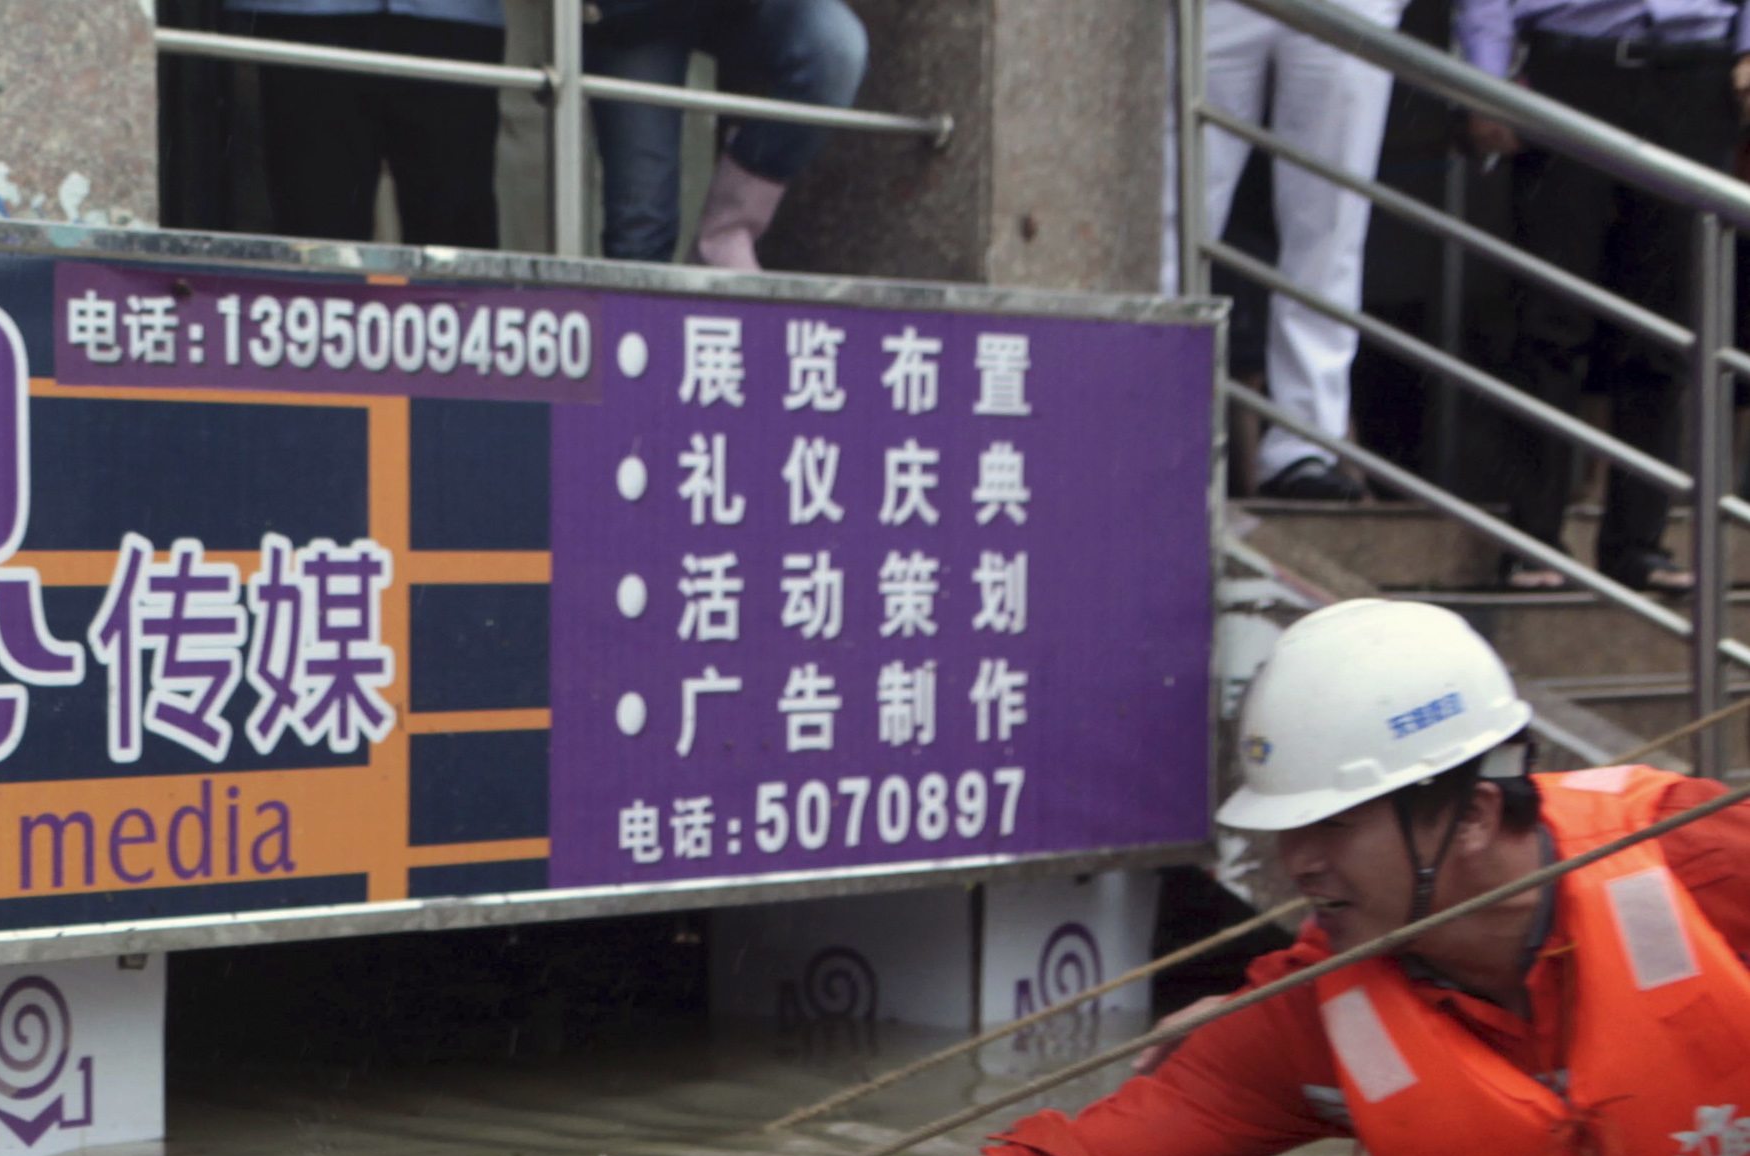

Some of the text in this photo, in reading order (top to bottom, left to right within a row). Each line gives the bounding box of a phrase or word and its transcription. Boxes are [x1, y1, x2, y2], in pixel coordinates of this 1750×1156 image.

[678, 314, 1032, 417] 展览布置
[677, 432, 1031, 527] 礼仪庆典
[676, 550, 1029, 642] 活动策划
[87, 531, 397, 763] 传媒
[675, 658, 1029, 757] 广告制作
[18, 778, 296, 891] media
